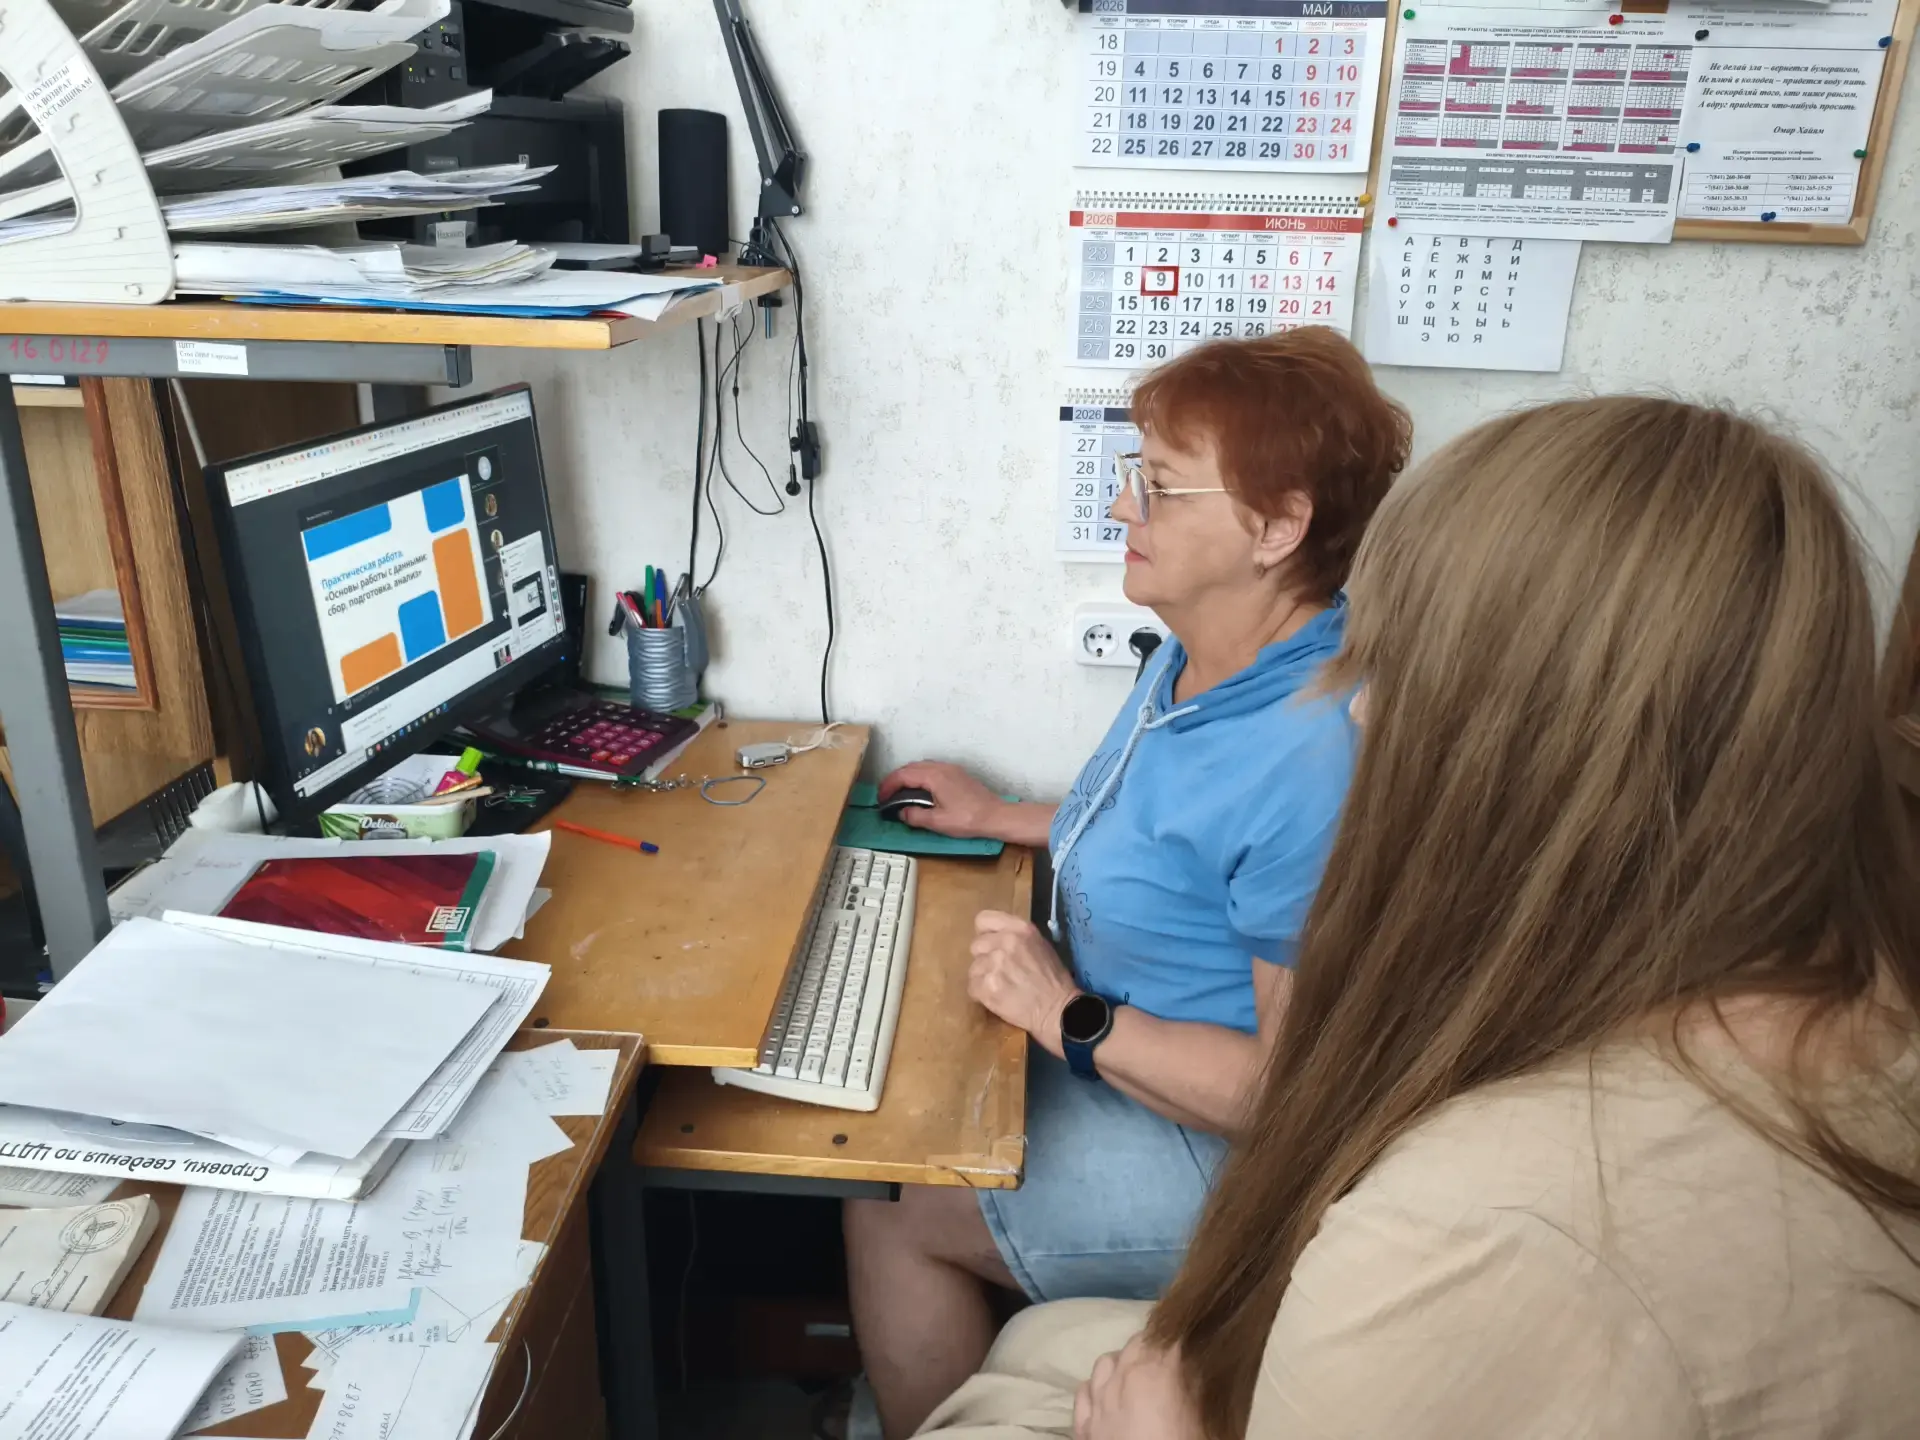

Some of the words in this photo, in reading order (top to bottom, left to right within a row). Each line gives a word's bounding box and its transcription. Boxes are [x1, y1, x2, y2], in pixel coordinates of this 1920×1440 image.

[1094, 0, 1125, 12] 2026
[1302, 1, 1333, 16] МАЙ
[1099, 33, 1118, 50] 18
[1274, 37, 1283, 54] 1
[1307, 38, 1320, 55] 2
[1343, 38, 1354, 55] 3
[1097, 60, 1117, 76] 19
[1134, 60, 1146, 77] 4
[1168, 61, 1180, 78] 5
[1202, 62, 1214, 79] 6
[1237, 63, 1249, 80] 7
[1271, 63, 1282, 81] 8
[1306, 64, 1317, 81] 9
[1336, 64, 1358, 82] 10
[1709, 62, 1722, 71] Не
[1770, 65, 1809, 74] вернется
[25, 65, 71, 102] ОКУМЕНТЫ
[1698, 75, 1710, 83] Не
[1782, 78, 1822, 86] придется
[1094, 86, 1115, 102] 20
[1129, 86, 1147, 103] 11
[1162, 87, 1183, 104] 12
[1196, 88, 1217, 105] 13
[1230, 89, 1251, 106] 14
[1264, 90, 1286, 107] 15
[1299, 90, 1320, 108] 16
[1334, 91, 1356, 108] 17
[1702, 87, 1714, 96] Не
[1715, 89, 1758, 98] оскорбляй
[1729, 101, 1769, 111] придется
[1092, 112, 1112, 128] 21
[1127, 112, 1147, 129] 18
[1160, 113, 1181, 130] 19
[1193, 114, 1215, 131] 20
[1226, 115, 1247, 132] 21
[1261, 116, 1283, 133] 22
[1294, 117, 1318, 134] 23
[1329, 117, 1352, 134] 24
[1773, 125, 1796, 135] Омар
[1797, 126, 1825, 134] Хайям
[1091, 137, 1112, 154] 22
[1124, 138, 1146, 155] 25
[1157, 139, 1180, 156] 26
[1191, 140, 1214, 157] 27
[1224, 141, 1247, 158] 28
[1258, 141, 1281, 159] 29
[1293, 143, 1315, 159] 30
[1327, 143, 1348, 160] 31
[1085, 213, 1115, 226] 2026
[1264, 216, 1307, 230] ИЮНЬ
[1313, 219, 1349, 232] JUNE
[1404, 236, 1414, 246] А
[1432, 236, 1442, 247] Б
[1459, 237, 1469, 248] В
[1486, 238, 1493, 249] Г
[1511, 239, 1523, 252] Д
[1126, 246, 1134, 262] 1
[1157, 247, 1168, 263] 2
[1190, 247, 1201, 264] 3
[1222, 248, 1234, 264] 4
[1256, 249, 1267, 265] 5
[1289, 250, 1299, 266] 6
[1323, 251, 1333, 266] 7
[1403, 251, 1412, 262] Е
[1430, 251, 1440, 263] Ё
[1456, 253, 1470, 264] Ж
[1483, 254, 1492, 265] З
[1510, 255, 1521, 265] И
[1123, 270, 1134, 286] 8
[1155, 272, 1167, 288] 9
[1184, 272, 1204, 288] 10
[1217, 273, 1235, 289] 11
[1250, 274, 1269, 289] 12
[1282, 275, 1302, 290] 13
[1315, 275, 1336, 291] 14
[1401, 267, 1411, 278] Й
[1428, 268, 1437, 279] К
[1454, 269, 1464, 280] Л
[1481, 270, 1493, 281] М
[1508, 271, 1518, 281] Н
[1400, 283, 1411, 294] О
[1427, 284, 1437, 295] П
[1453, 285, 1463, 295] Р
[1479, 286, 1489, 297] С
[1507, 286, 1515, 297] Т
[1118, 295, 1138, 311] 15
[1150, 296, 1170, 312] 16
[1182, 296, 1203, 312] 17
[1215, 297, 1235, 313] 18
[1247, 298, 1267, 314] 19
[1278, 299, 1300, 314] 20
[1311, 300, 1332, 316] 21
[1398, 299, 1407, 310] У
[1425, 300, 1435, 310] Ф
[1451, 301, 1460, 311] Х
[1477, 302, 1487, 314] Ц
[1503, 302, 1513, 313] Ч
[1115, 319, 1136, 335] 22
[1147, 320, 1168, 336] 23
[1179, 321, 1201, 336] 24
[1212, 321, 1233, 337] 25
[1244, 321, 1266, 338] 26
[1397, 315, 1409, 325] Ш
[1423, 316, 1436, 328] Щ
[1450, 316, 1460, 327] Ъ
[1475, 317, 1487, 328] Ы
[1501, 318, 1511, 329] Ь
[1421, 332, 1430, 343] Э
[1447, 333, 1460, 343] Ю
[1473, 333, 1483, 344] Я
[1114, 343, 1135, 358] 29
[1146, 343, 1167, 359] 30
[1074, 409, 1102, 420] 2026
[1077, 438, 1097, 452] 27
[1075, 460, 1095, 475] 28
[1074, 483, 1094, 497] 29
[1074, 504, 1093, 519] 30
[1072, 526, 1089, 540] 31
[1102, 527, 1123, 541] 27
[321, 559, 377, 590] Практическая
[324, 582, 360, 602] «Основы
[360, 570, 388, 589] работы
[393, 553, 428, 575] данными:
[54, 1148, 82, 1161] по
[82, 1151, 177, 1172] сведения
[183, 1157, 270, 1183] Справки,
